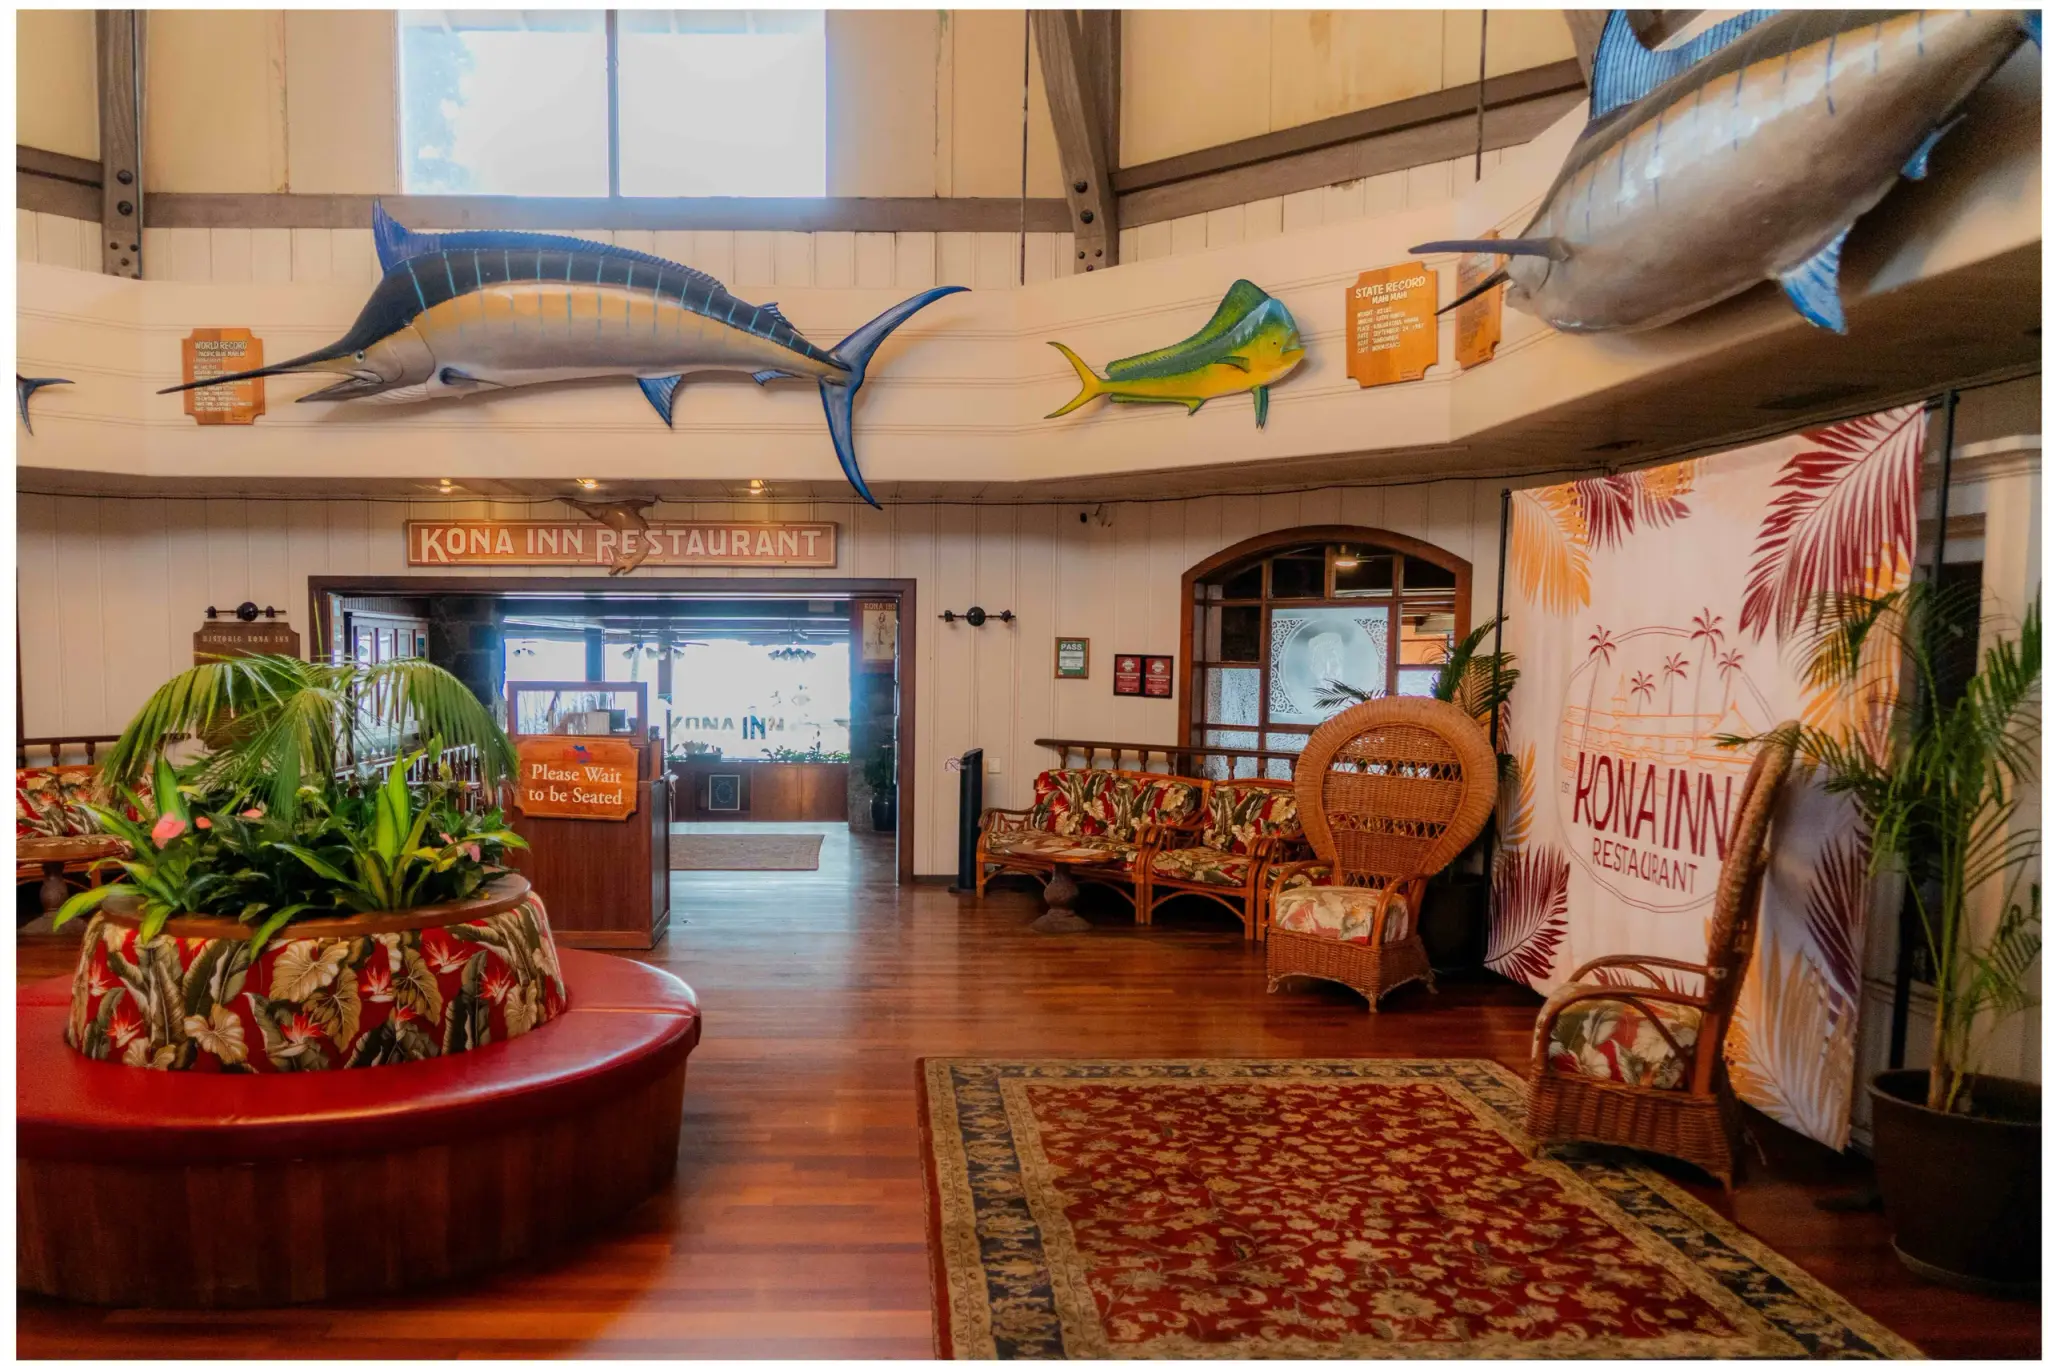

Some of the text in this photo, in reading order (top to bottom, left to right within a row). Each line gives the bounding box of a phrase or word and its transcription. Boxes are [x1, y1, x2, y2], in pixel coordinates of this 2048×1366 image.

[1355, 276, 1425, 299] STATE RECORD
[1372, 291, 1407, 304] MAHI MAHI
[195, 341, 247, 350] WORLD RECORD
[420, 526, 822, 564] KONA INN RESTAURANT
[202, 635, 289, 643] HISTORIC KONA INN
[1060, 643, 1082, 651] PASS
[531, 763, 622, 784] Please Wait
[528, 785, 623, 805] to be Seated
[1573, 751, 1733, 861] KONA INN
[1592, 837, 1698, 894] RESTAURANT
